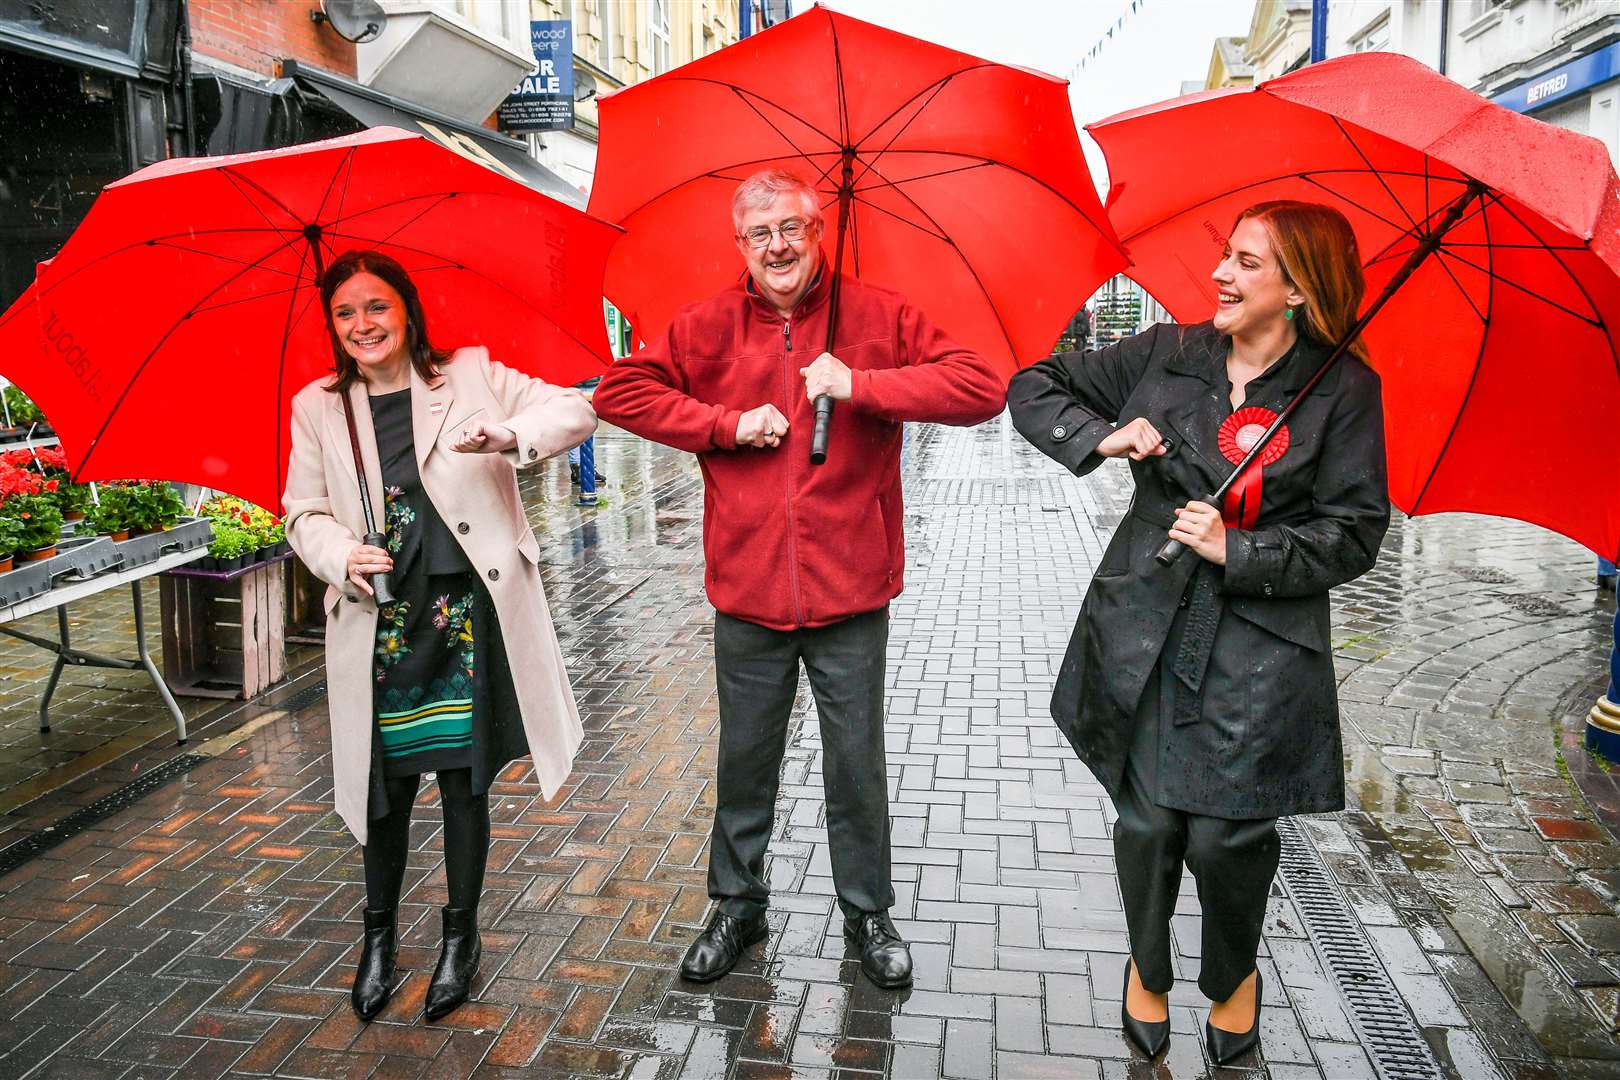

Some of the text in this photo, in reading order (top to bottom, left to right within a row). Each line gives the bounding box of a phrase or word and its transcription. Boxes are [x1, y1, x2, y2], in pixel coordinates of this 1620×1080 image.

[532, 28, 566, 39] wood
[532, 41, 560, 50] eere
[528, 59, 555, 76] OR
[1527, 73, 1568, 105] BETFRED
